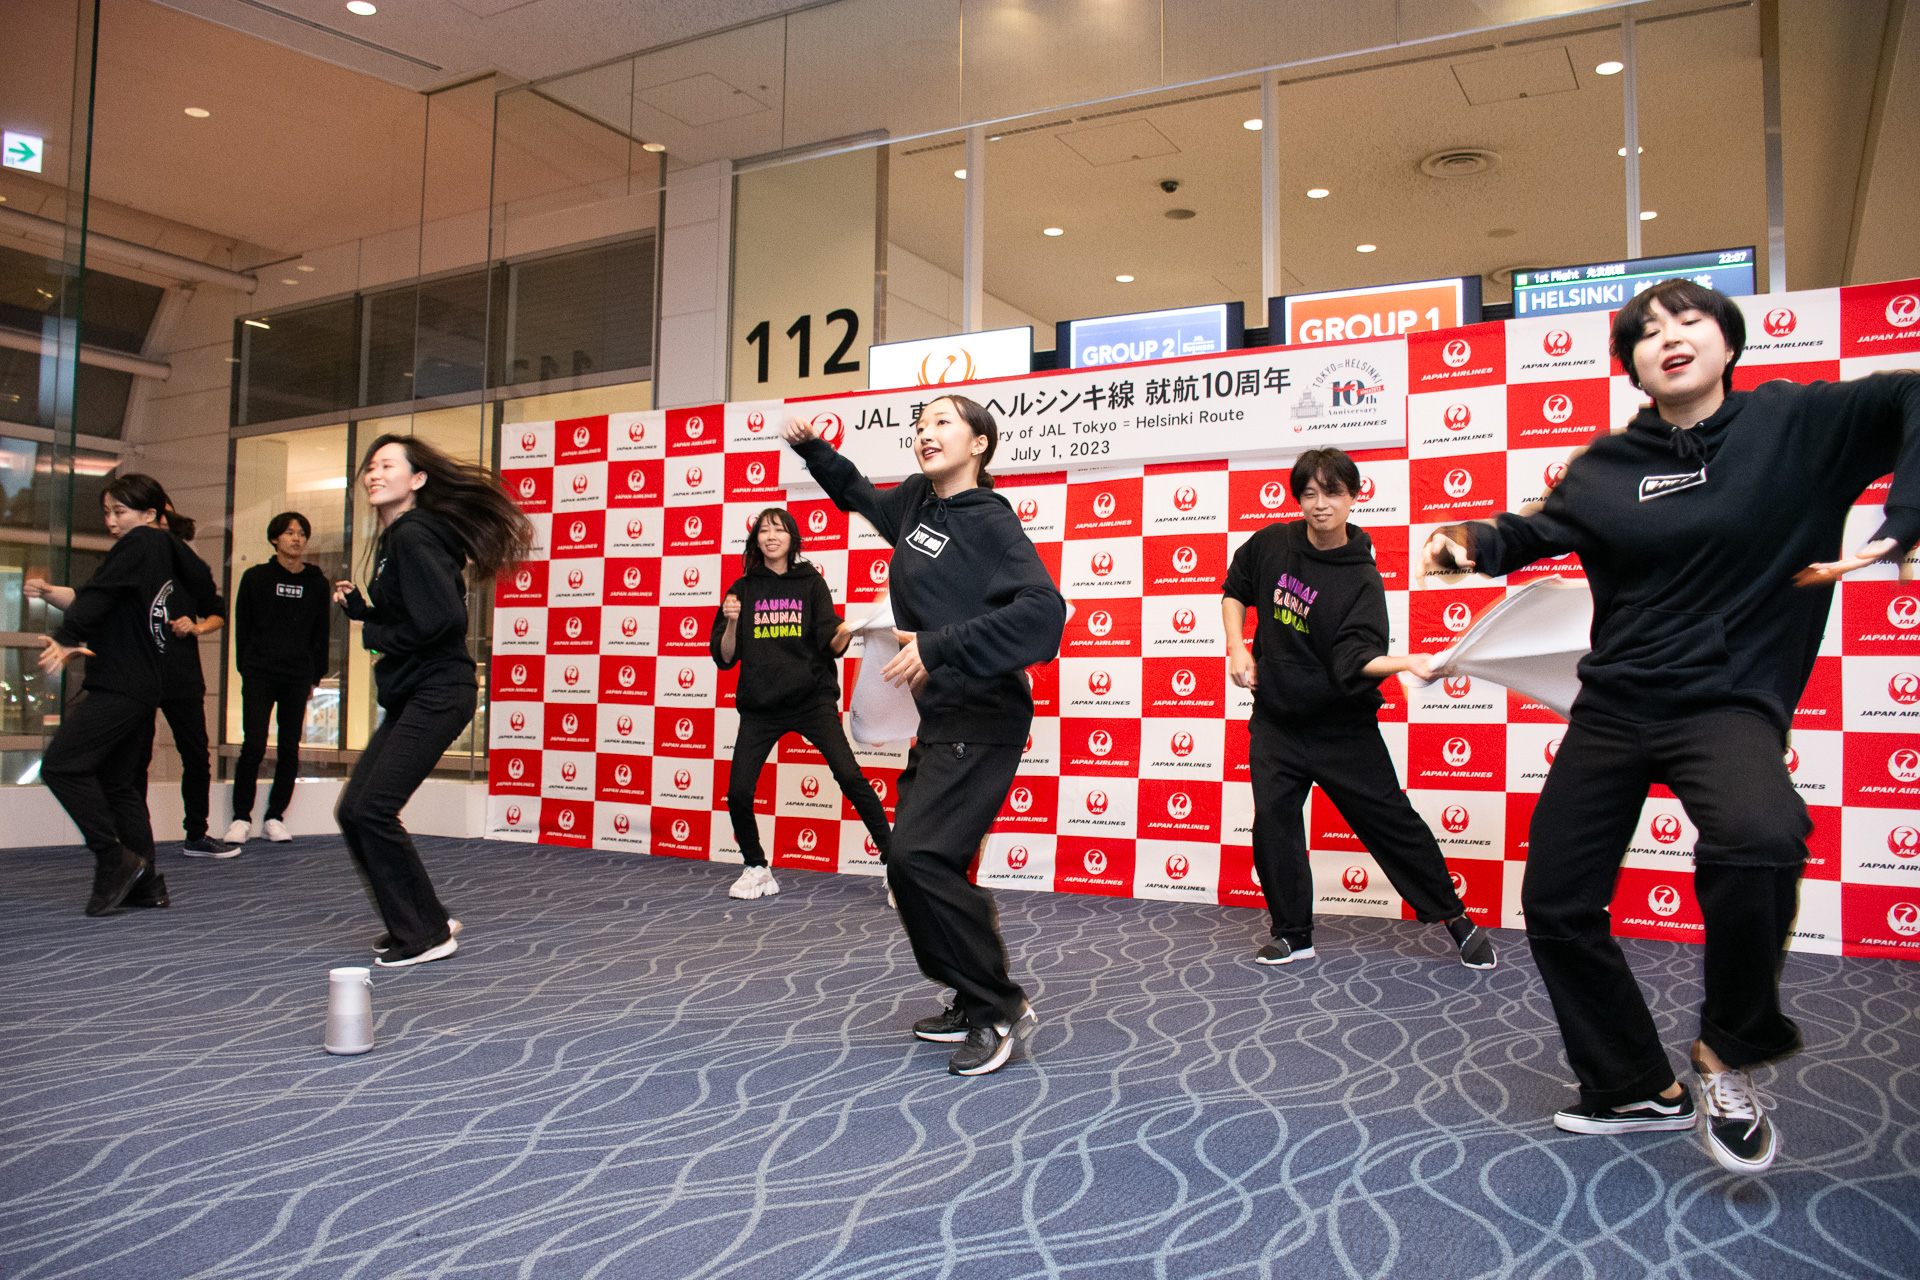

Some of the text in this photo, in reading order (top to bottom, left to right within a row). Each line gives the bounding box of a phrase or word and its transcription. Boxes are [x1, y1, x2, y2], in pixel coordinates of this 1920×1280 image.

[1719, 252, 1747, 264] 22:07
[1531, 284, 1624, 310] HELSINKI
[1299, 307, 1439, 344] GROUP 1
[1773, 326, 1791, 335] JAL
[1857, 334, 1893, 343] JAPAN
[746, 308, 860, 383] 112
[1549, 346, 1568, 355] JAL
[1082, 338, 1175, 366] GROUP 2
[1421, 367, 1493, 381] JAPAN AIRLINES
[855, 407, 900, 430] JAL
[1146, 367, 1291, 406] 就航10周年
[1328, 407, 1377, 416] Anniversary
[1019, 426, 1033, 438] of
[1039, 424, 1066, 437] JAL
[1073, 420, 1117, 434] Tokyo
[1136, 412, 1193, 429] Helsinki
[1200, 409, 1244, 424] Route
[1340, 419, 1387, 428] AIRLINES
[1449, 421, 1466, 429] JAL
[1551, 425, 1596, 434] AIRLINES
[1452, 433, 1493, 441] AIRLINES
[1011, 440, 1110, 461] July 1, 2023
[1450, 488, 1466, 496] JAL
[1451, 499, 1494, 508] AIRLINES
[755, 598, 802, 611] SAUNA!
[754, 611, 802, 625] SAUNA!
[754, 624, 801, 638] SAUNA!
[1622, 918, 1704, 930] JAPAN AIRLINES
